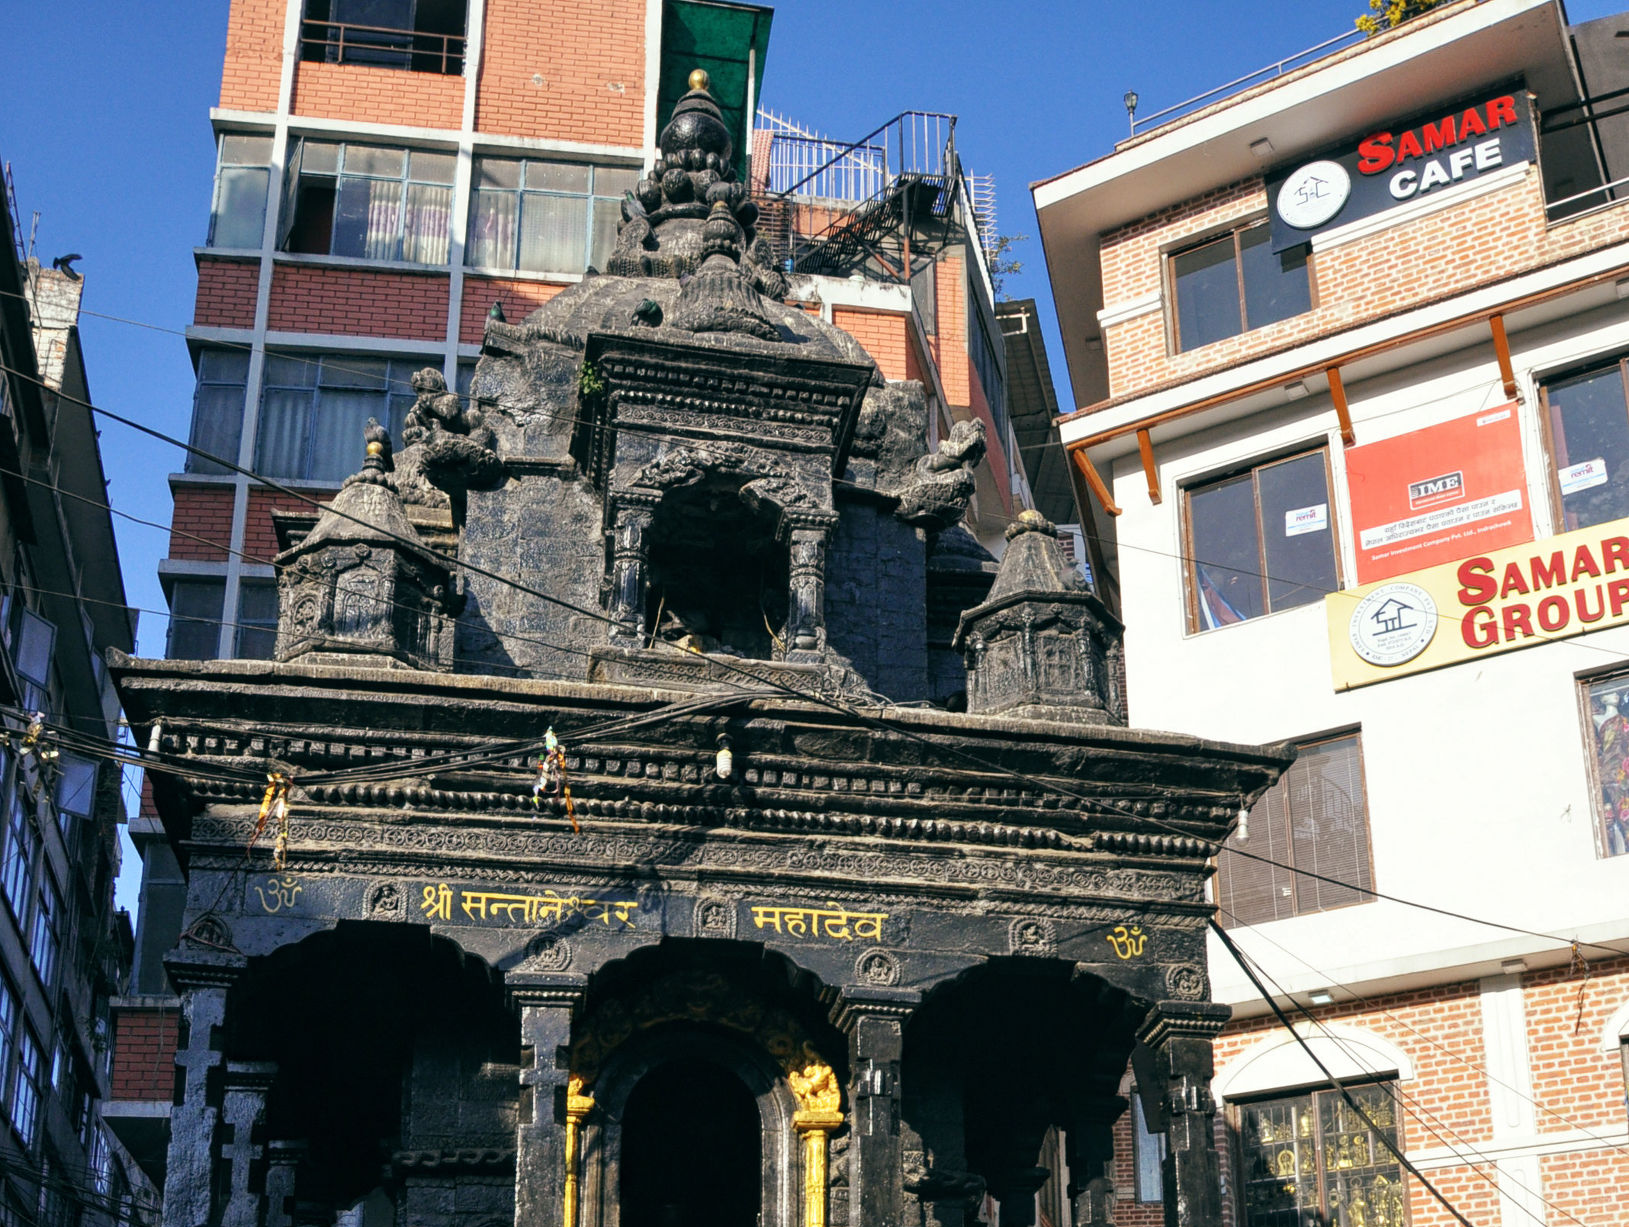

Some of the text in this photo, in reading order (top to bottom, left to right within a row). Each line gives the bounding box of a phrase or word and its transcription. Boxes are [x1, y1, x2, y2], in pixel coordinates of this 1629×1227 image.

[1357, 95, 1517, 176] SAMAR
[1389, 137, 1503, 202] CAFE
[1417, 476, 1460, 496] IME
[1457, 536, 1629, 606] SAMAR
[1461, 578, 1629, 649] GROUP
[421, 882, 452, 921] श्री
[750, 901, 889, 943] महादेव
[1106, 925, 1148, 961] ॐ
